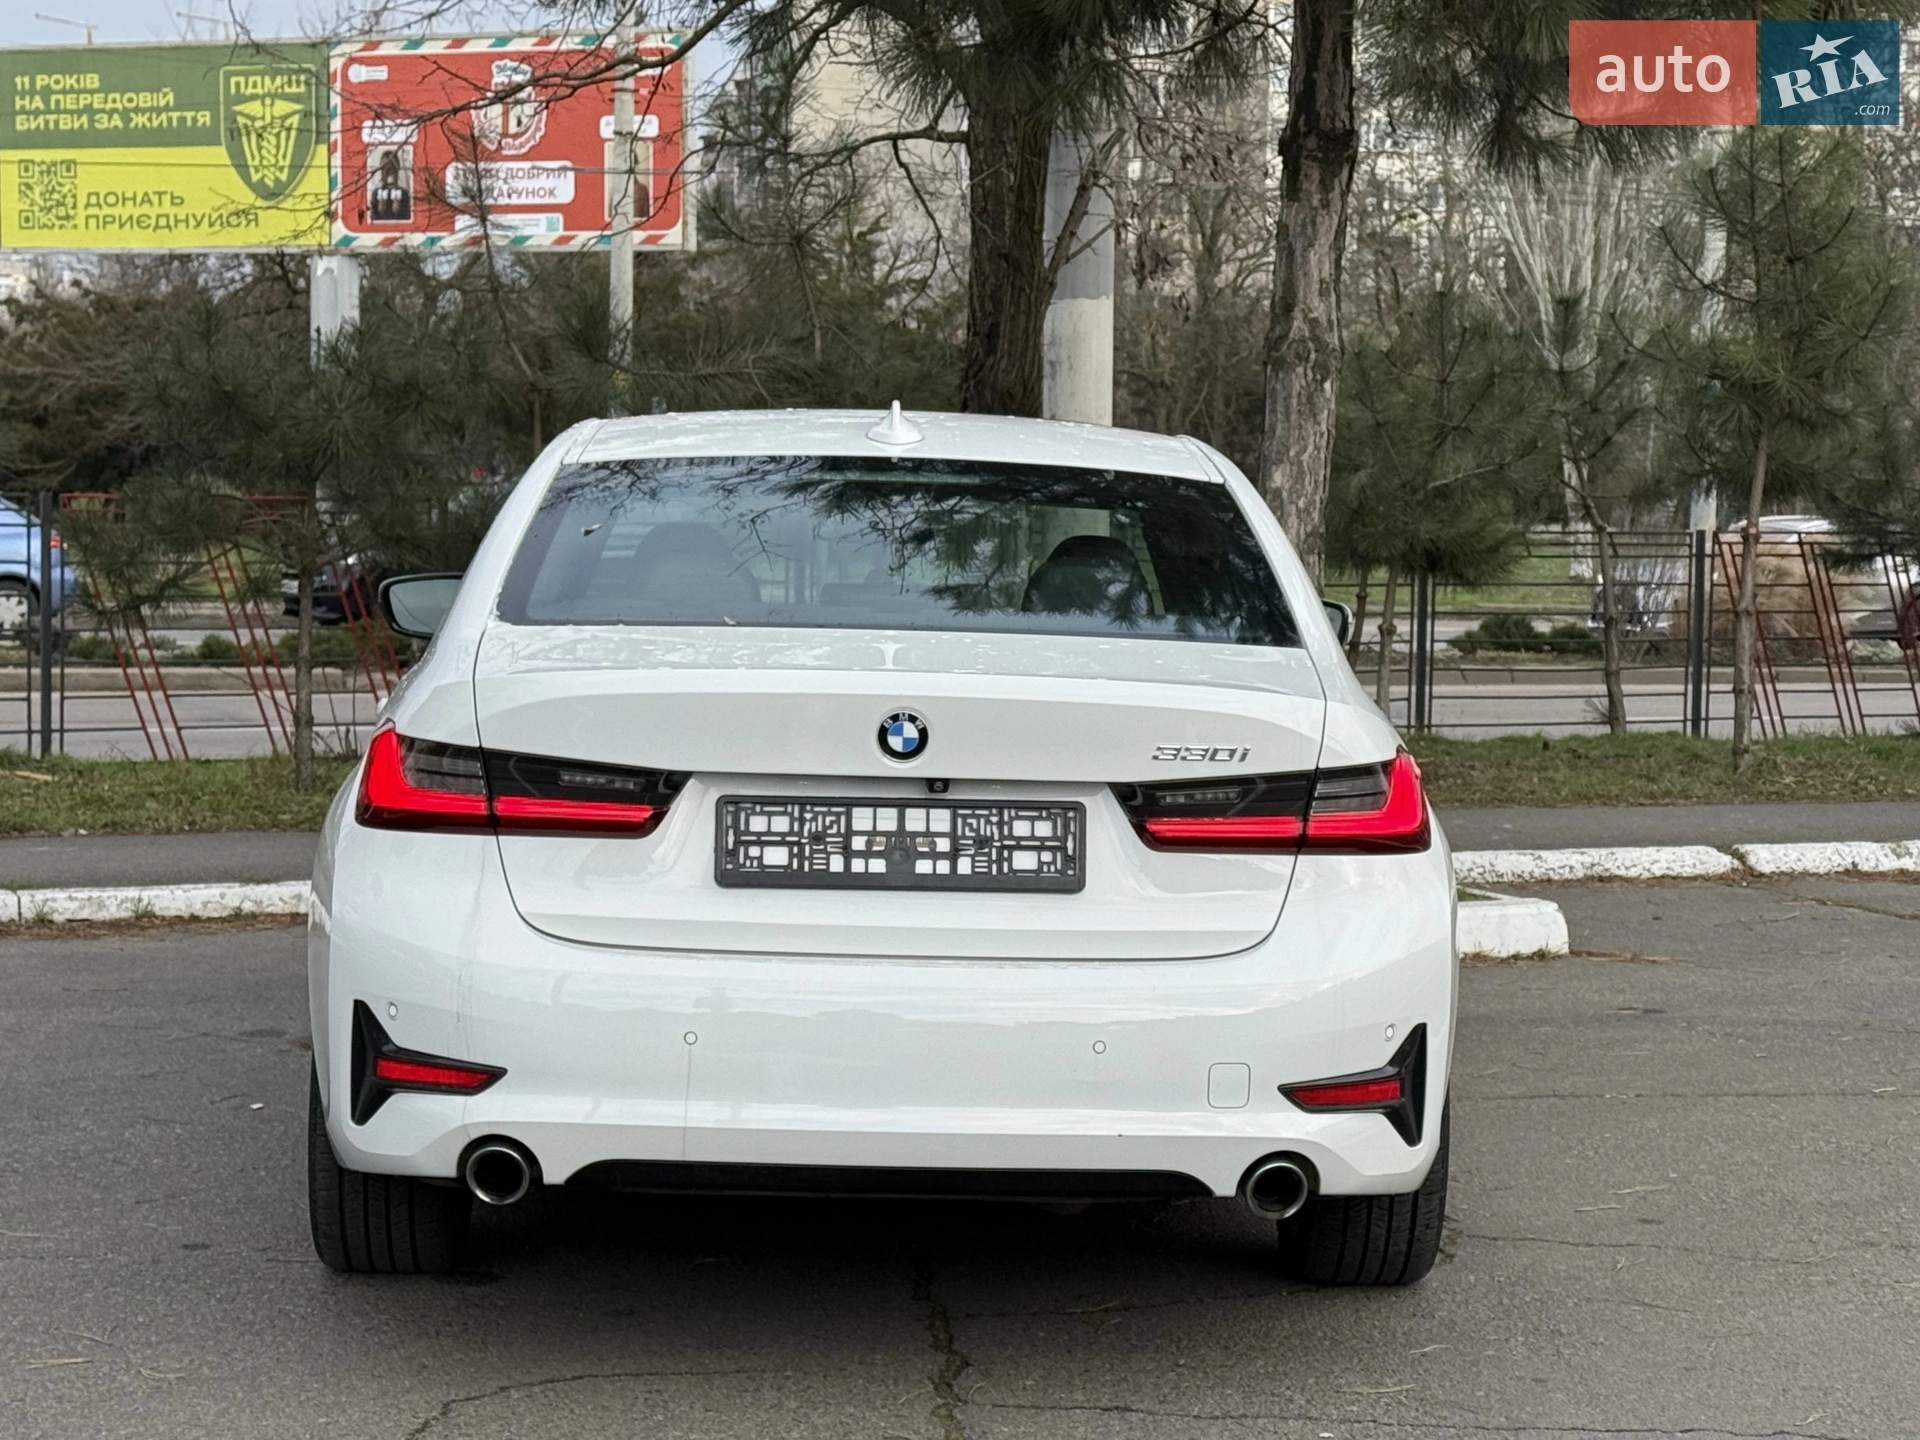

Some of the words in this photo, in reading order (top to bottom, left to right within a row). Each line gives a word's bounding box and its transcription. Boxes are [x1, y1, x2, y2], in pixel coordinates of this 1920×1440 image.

[14, 76, 29, 91] 11
[36, 73, 100, 90] РОКІВ
[230, 74, 306, 95] ПДМШ
[15, 94, 45, 111] НА
[50, 87, 174, 109] ПЕРЕДОВІЙ
[15, 113, 88, 131] БИТВИ
[94, 112, 123, 129] ЗА
[129, 110, 211, 128] ЖИТТЯ
[84, 190, 185, 210] ДОНАТЬ
[84, 209, 259, 231] ПРИЄДНУЙСЯ
[882, 712, 926, 731] BMW
[1152, 743, 1253, 763] 330i
